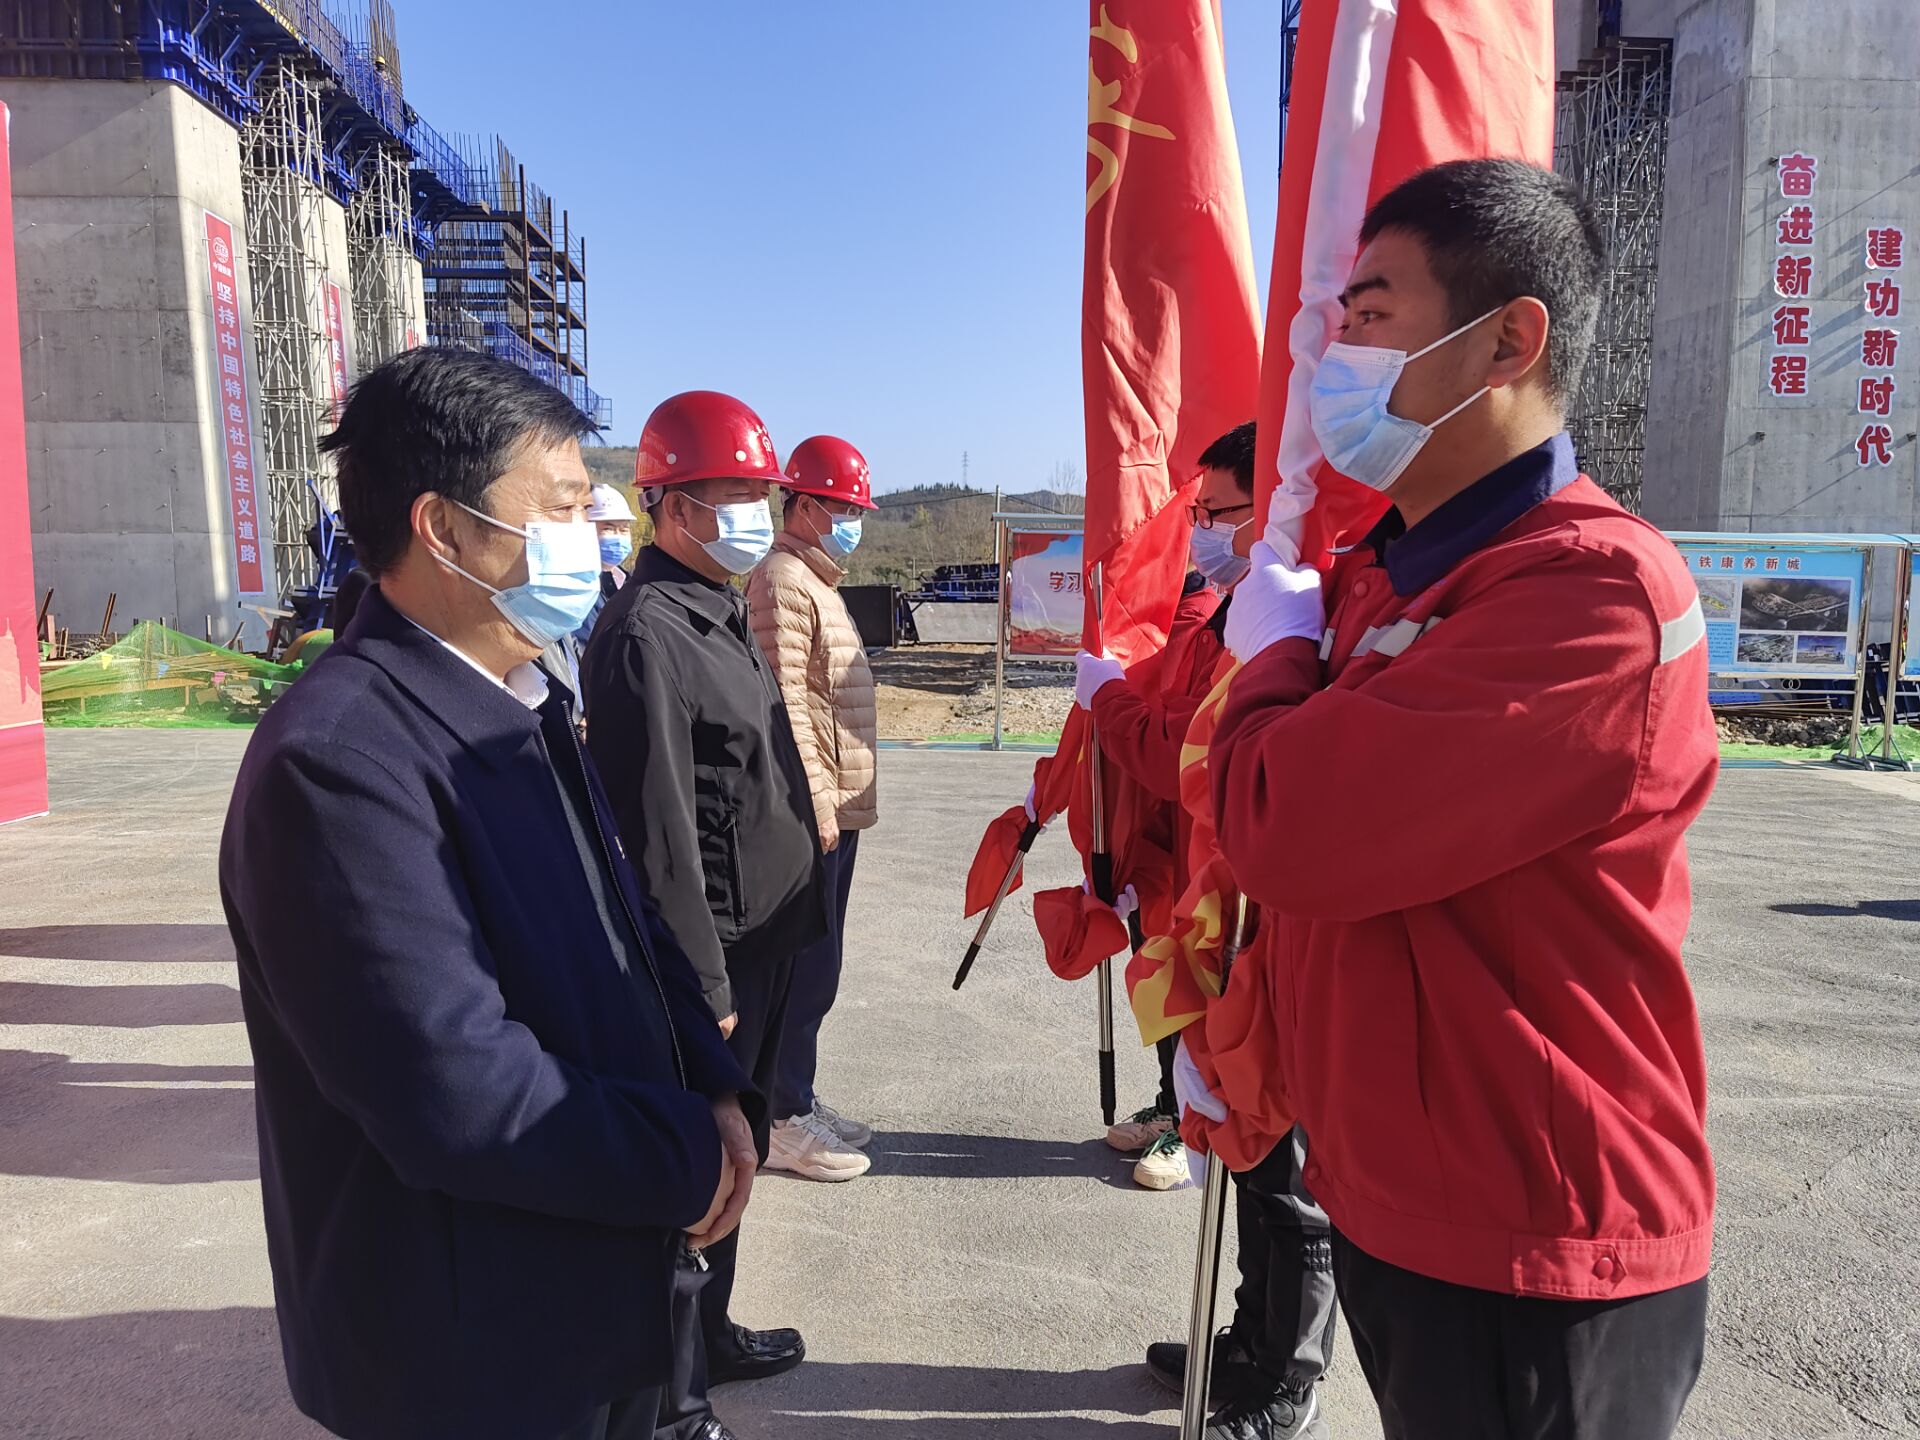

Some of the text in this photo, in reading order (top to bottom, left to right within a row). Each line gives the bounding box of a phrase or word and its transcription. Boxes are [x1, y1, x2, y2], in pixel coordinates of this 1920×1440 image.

[1770, 152, 1816, 396] 奋进新征程
[1857, 227, 1903, 466] 建功新时代
[216, 281, 257, 563] 坚持中国特色社会主义道路
[1049, 571, 1082, 591] 学习
